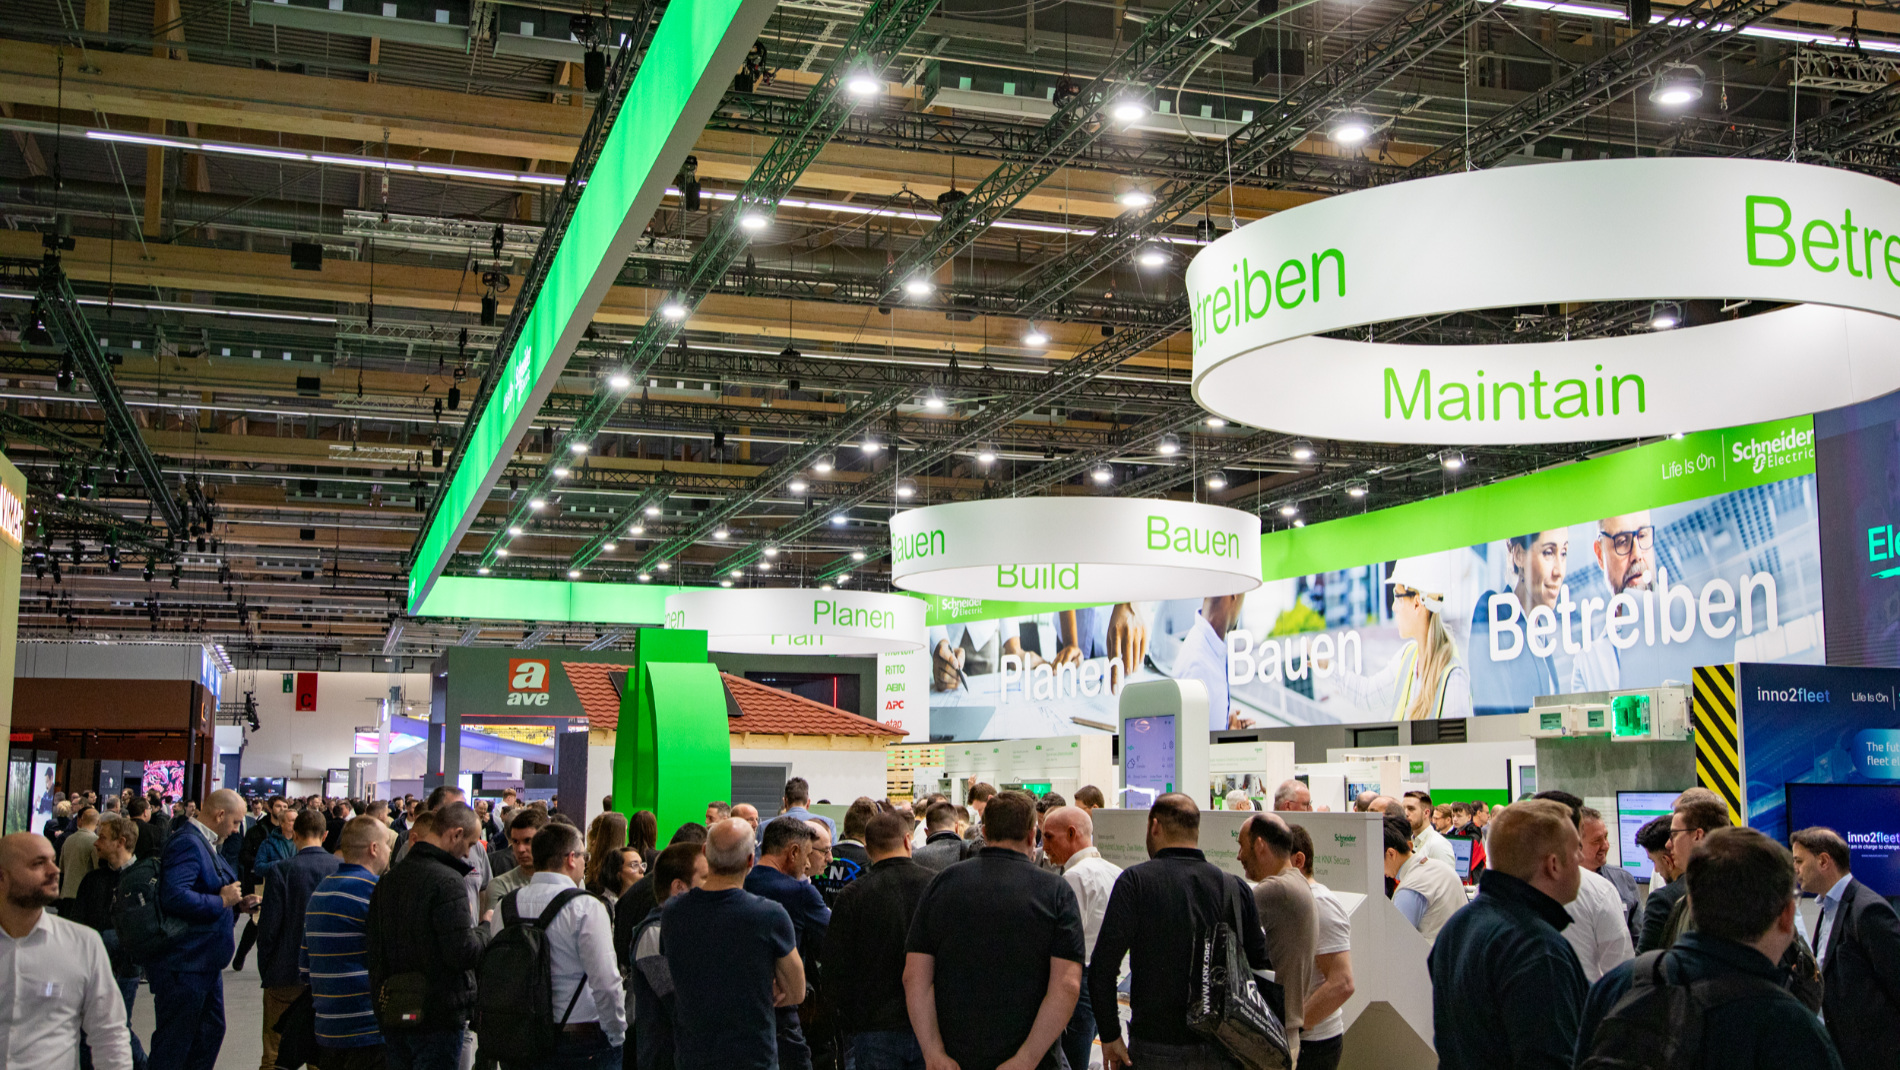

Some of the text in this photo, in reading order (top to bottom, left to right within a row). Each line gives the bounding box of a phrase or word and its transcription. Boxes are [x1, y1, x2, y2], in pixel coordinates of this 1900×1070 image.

[1383, 363, 1646, 421] Maintain
[1731, 428, 1814, 463] Schneider
[1661, 452, 1716, 480] Life Is On
[1767, 448, 1814, 469] Electric
[1146, 515, 1240, 560] Bauen
[1867, 523, 1900, 562] El
[997, 563, 1080, 591] Build
[941, 596, 983, 611] Schneider
[1487, 566, 1779, 662] Betreiben
[813, 600, 895, 630] Planen
[1225, 628, 1362, 685] Bauen
[1000, 652, 1125, 701] Planen
[885, 683, 906, 693] ABN
[1757, 686, 1831, 703] inno2fleet
[1851, 692, 1889, 703] Life Is On
[300, 693, 312, 708] C
[506, 692, 550, 706] ave
[885, 700, 905, 711] APC
[1865, 741, 1884, 752] The
[1866, 755, 1890, 767] fleet
[1847, 831, 1900, 844] inno2fleet
